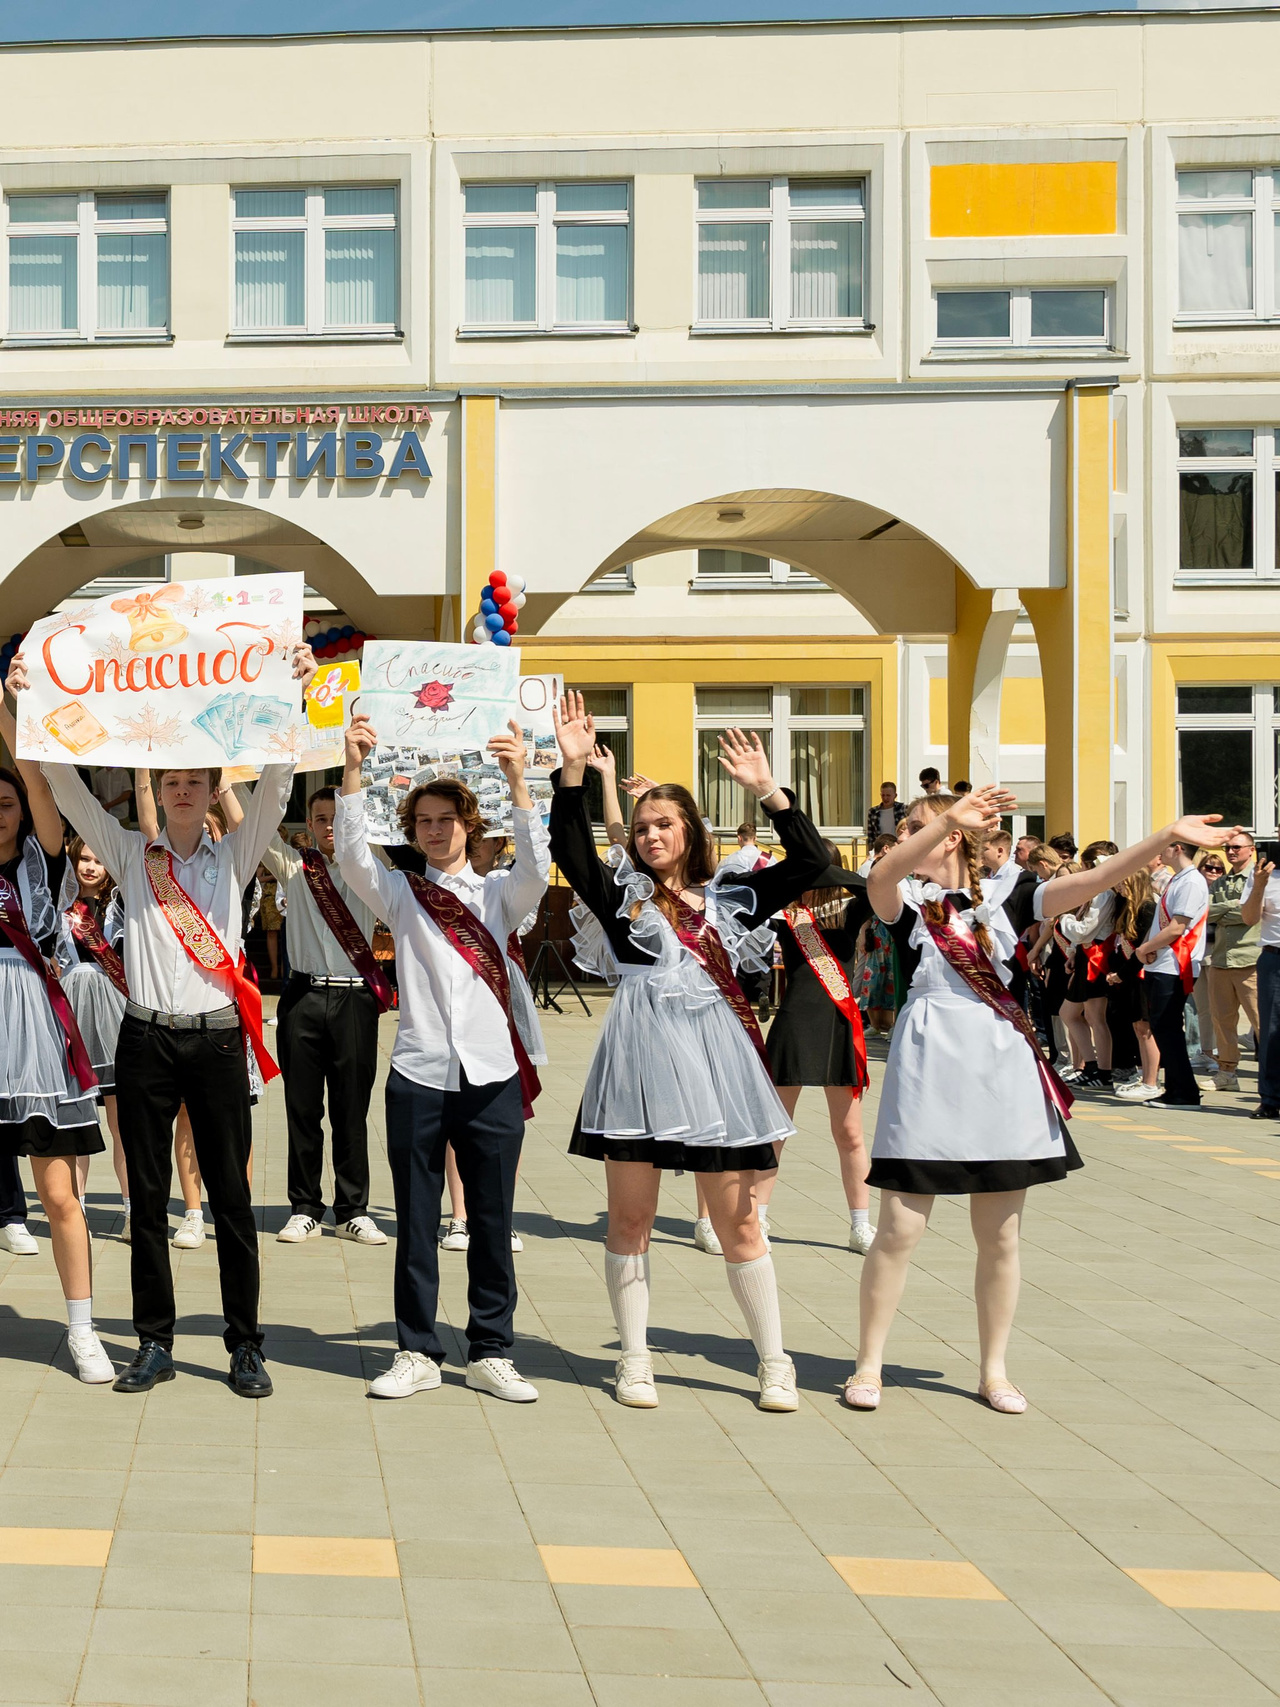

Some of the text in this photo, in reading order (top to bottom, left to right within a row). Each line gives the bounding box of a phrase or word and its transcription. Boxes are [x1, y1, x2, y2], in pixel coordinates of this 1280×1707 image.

[46, 407, 340, 430] ОБЩЕОБРАЗОВАТЕЛЬНАЯ
[346, 406, 433, 424] ШКОЛА
[42, 625, 275, 695] Спасибо
